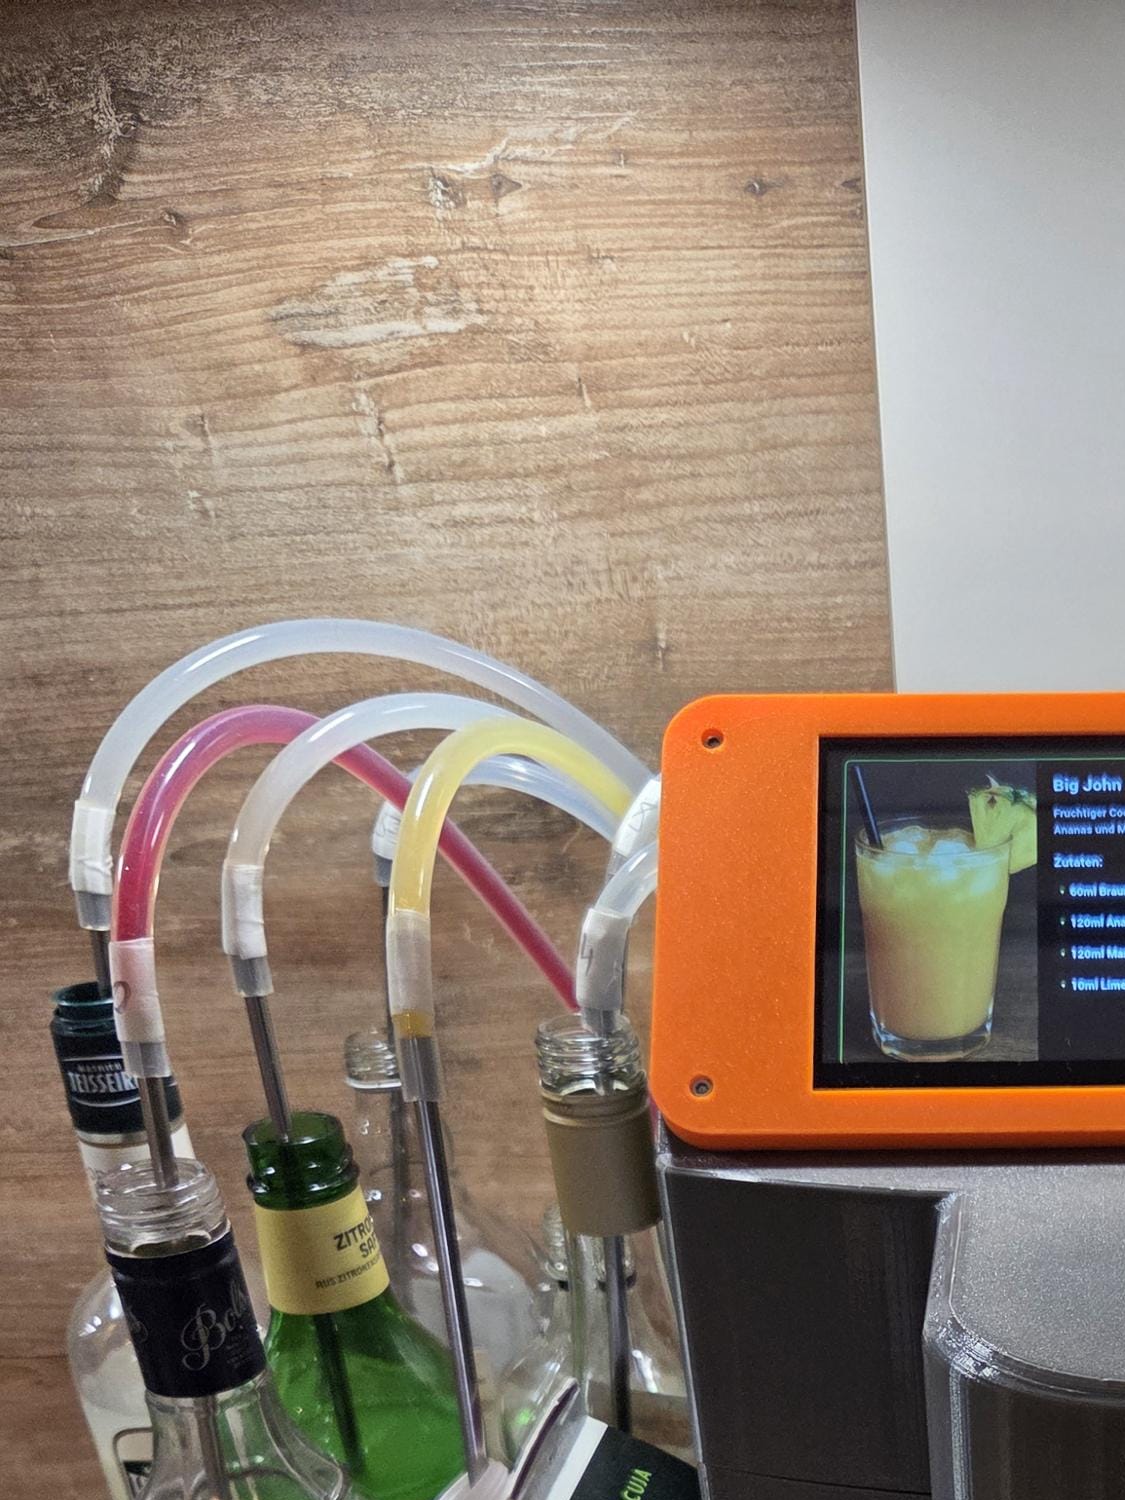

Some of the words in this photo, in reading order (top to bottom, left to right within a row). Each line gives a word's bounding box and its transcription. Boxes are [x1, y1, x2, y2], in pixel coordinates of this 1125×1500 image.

[1053, 774, 1079, 794] Big
[1083, 773, 1122, 793] John
[1054, 823, 1093, 835] Ananas
[1095, 823, 1115, 835] und
[1053, 853, 1104, 868] Zutaten:
[1069, 882, 1097, 897] 60ml
[1071, 913, 1104, 928] 120ml
[1071, 945, 1104, 960] 120ml
[1071, 976, 1098, 991] 10ml
